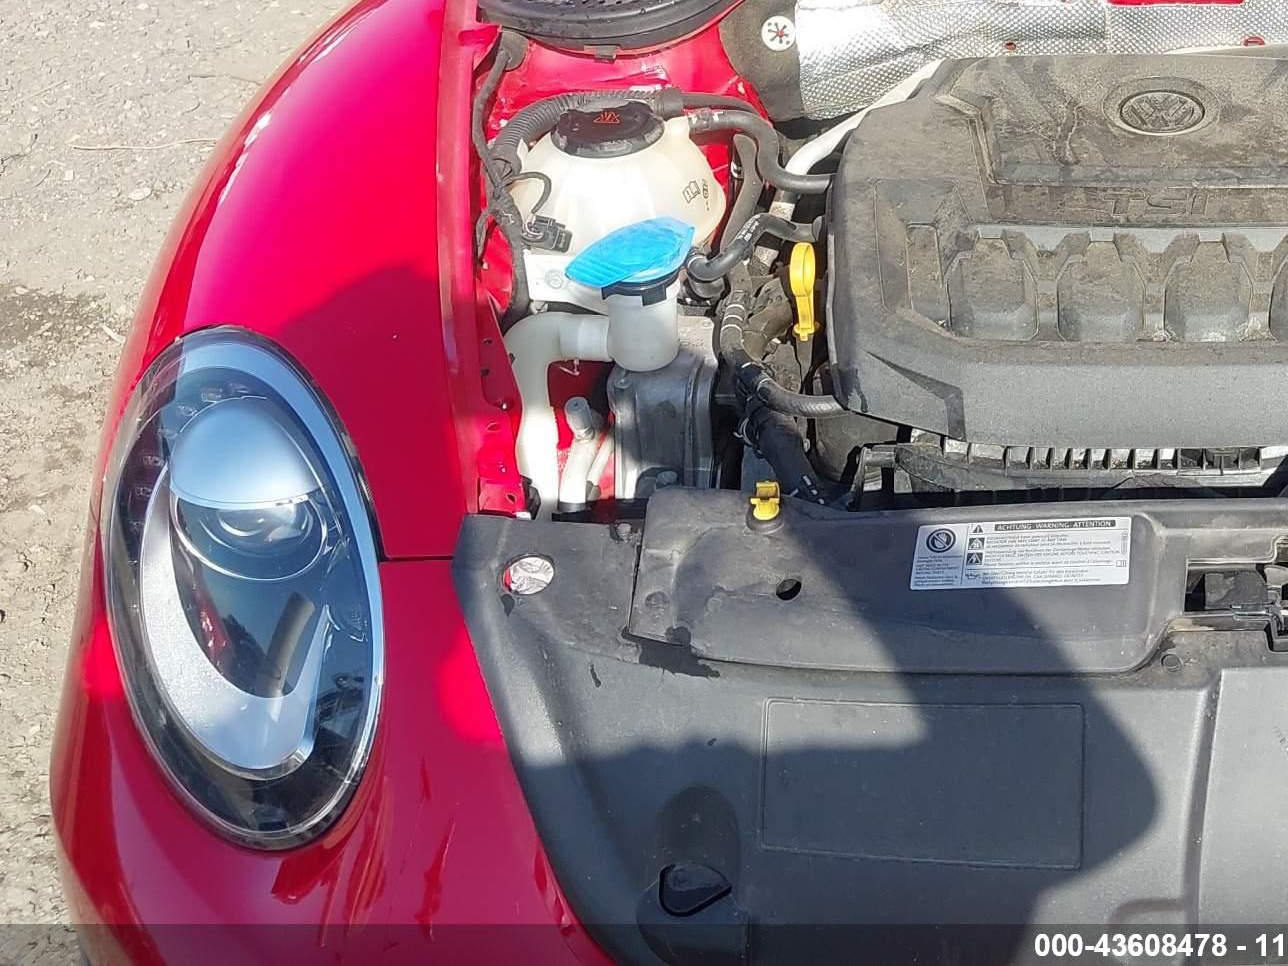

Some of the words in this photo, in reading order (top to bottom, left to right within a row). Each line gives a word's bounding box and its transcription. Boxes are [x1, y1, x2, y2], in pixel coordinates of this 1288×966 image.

[1103, 193, 1209, 216] TSI
[997, 523, 1032, 531] ACHTUNG
[1035, 521, 1070, 530] WARNING
[1073, 520, 1112, 529] ATTENTION
